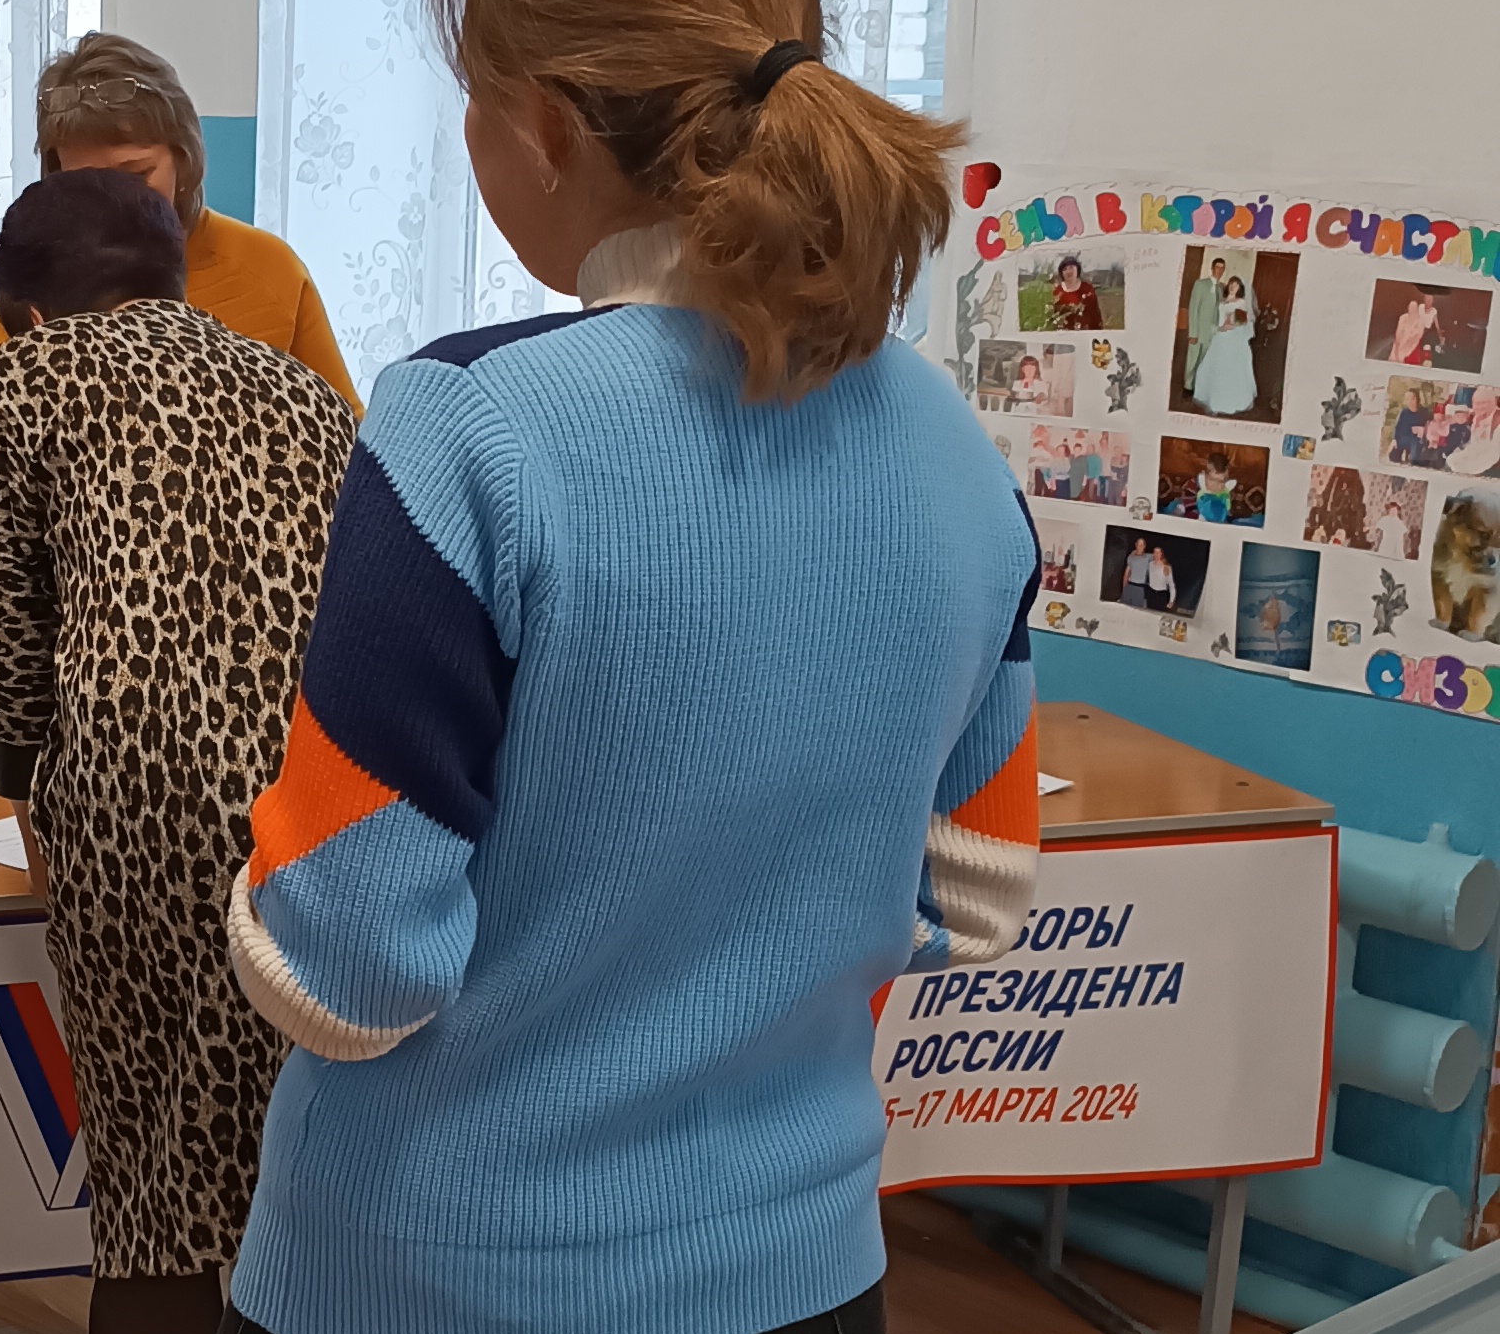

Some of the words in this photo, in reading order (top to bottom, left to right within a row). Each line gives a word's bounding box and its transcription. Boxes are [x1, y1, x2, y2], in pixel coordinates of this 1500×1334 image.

[976, 196, 1085, 261] СЕМЬЯ
[1095, 192, 1127, 234] В
[1282, 203, 1312, 244] Я
[1315, 207, 1500, 282] СЧАСТЛИ
[908, 962, 1185, 1020] ПРЕЗИДЕНТА
[884, 1029, 1065, 1084] РОССИИ
[944, 1086, 1059, 1125] МАРТА
[1059, 1083, 1139, 1123] 2024
